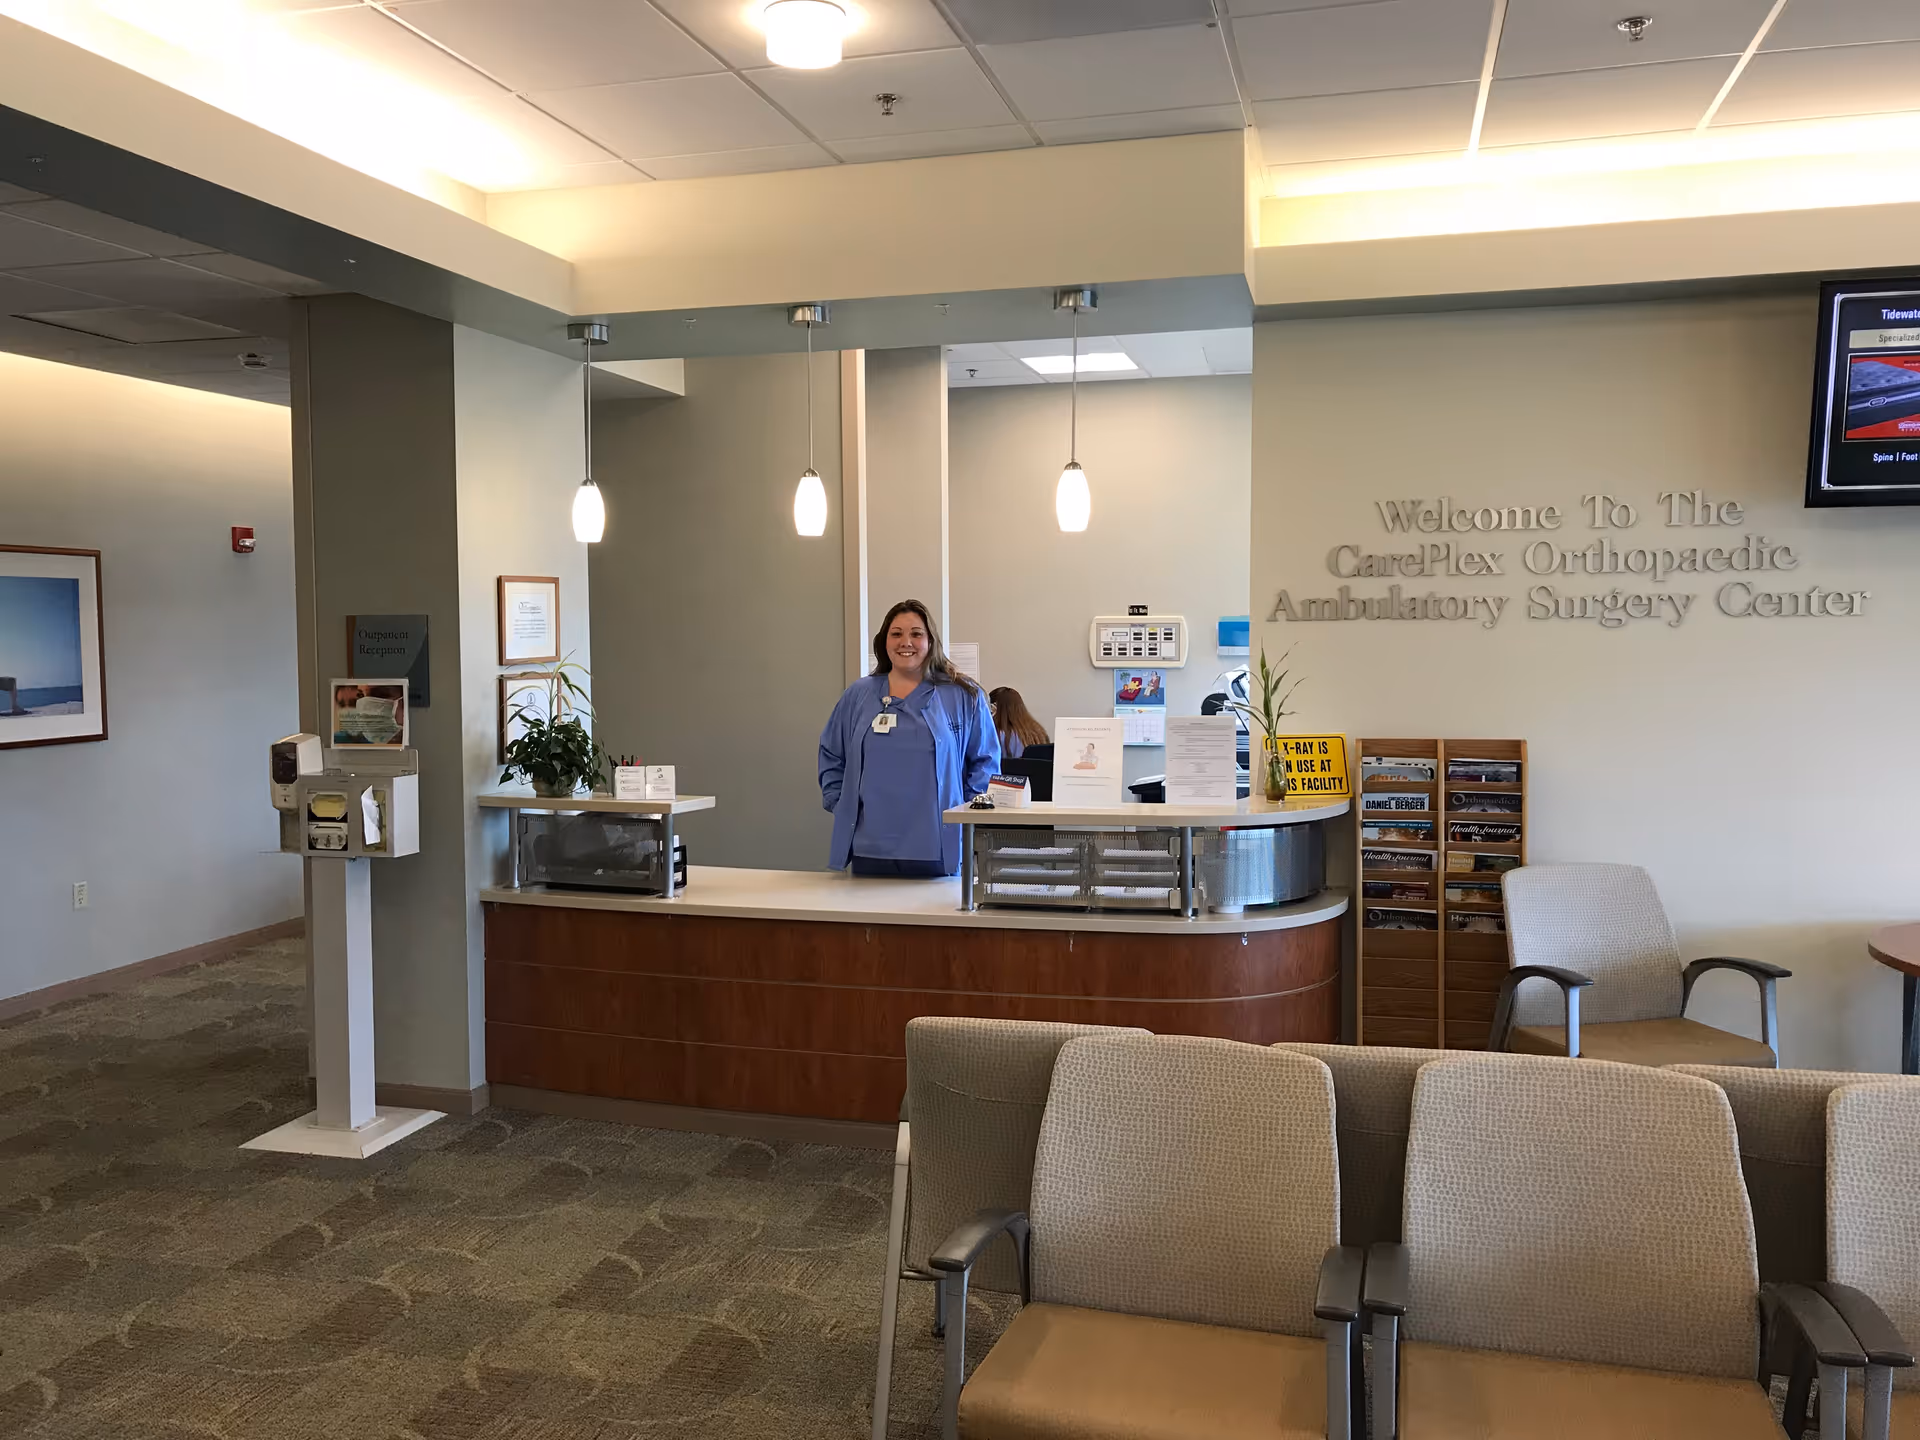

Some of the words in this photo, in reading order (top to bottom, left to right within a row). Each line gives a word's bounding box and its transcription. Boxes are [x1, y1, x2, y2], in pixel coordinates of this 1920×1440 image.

[1878, 333, 1920, 344] Specialized
[1873, 452, 1894, 463] Spine
[1901, 452, 1918, 461] Foot
[1376, 496, 1562, 533] Welcome
[1582, 494, 1638, 529] To
[1657, 489, 1745, 527] The
[1326, 541, 1504, 578] CarePlex
[1525, 534, 1798, 582] Orthopaedic
[1266, 585, 1510, 629] Ambulatory
[1528, 585, 1697, 628] Surgery
[1716, 582, 1873, 618] Center
[359, 629, 409, 642] Outpatient
[359, 644, 406, 657] Reception
[1283, 742, 1313, 755] X-RAY
[1318, 741, 1328, 754] IS
[1297, 760, 1316, 772] USE
[1320, 759, 1331, 772] AT
[1301, 777, 1344, 791] FACILITY
[1365, 800, 1393, 809] DANIEL
[1395, 800, 1425, 810] BERGER
[1450, 824, 1479, 834] Health
[1480, 826, 1517, 834] Journal
[1364, 852, 1391, 861] Health
[1392, 853, 1430, 862] Journal
